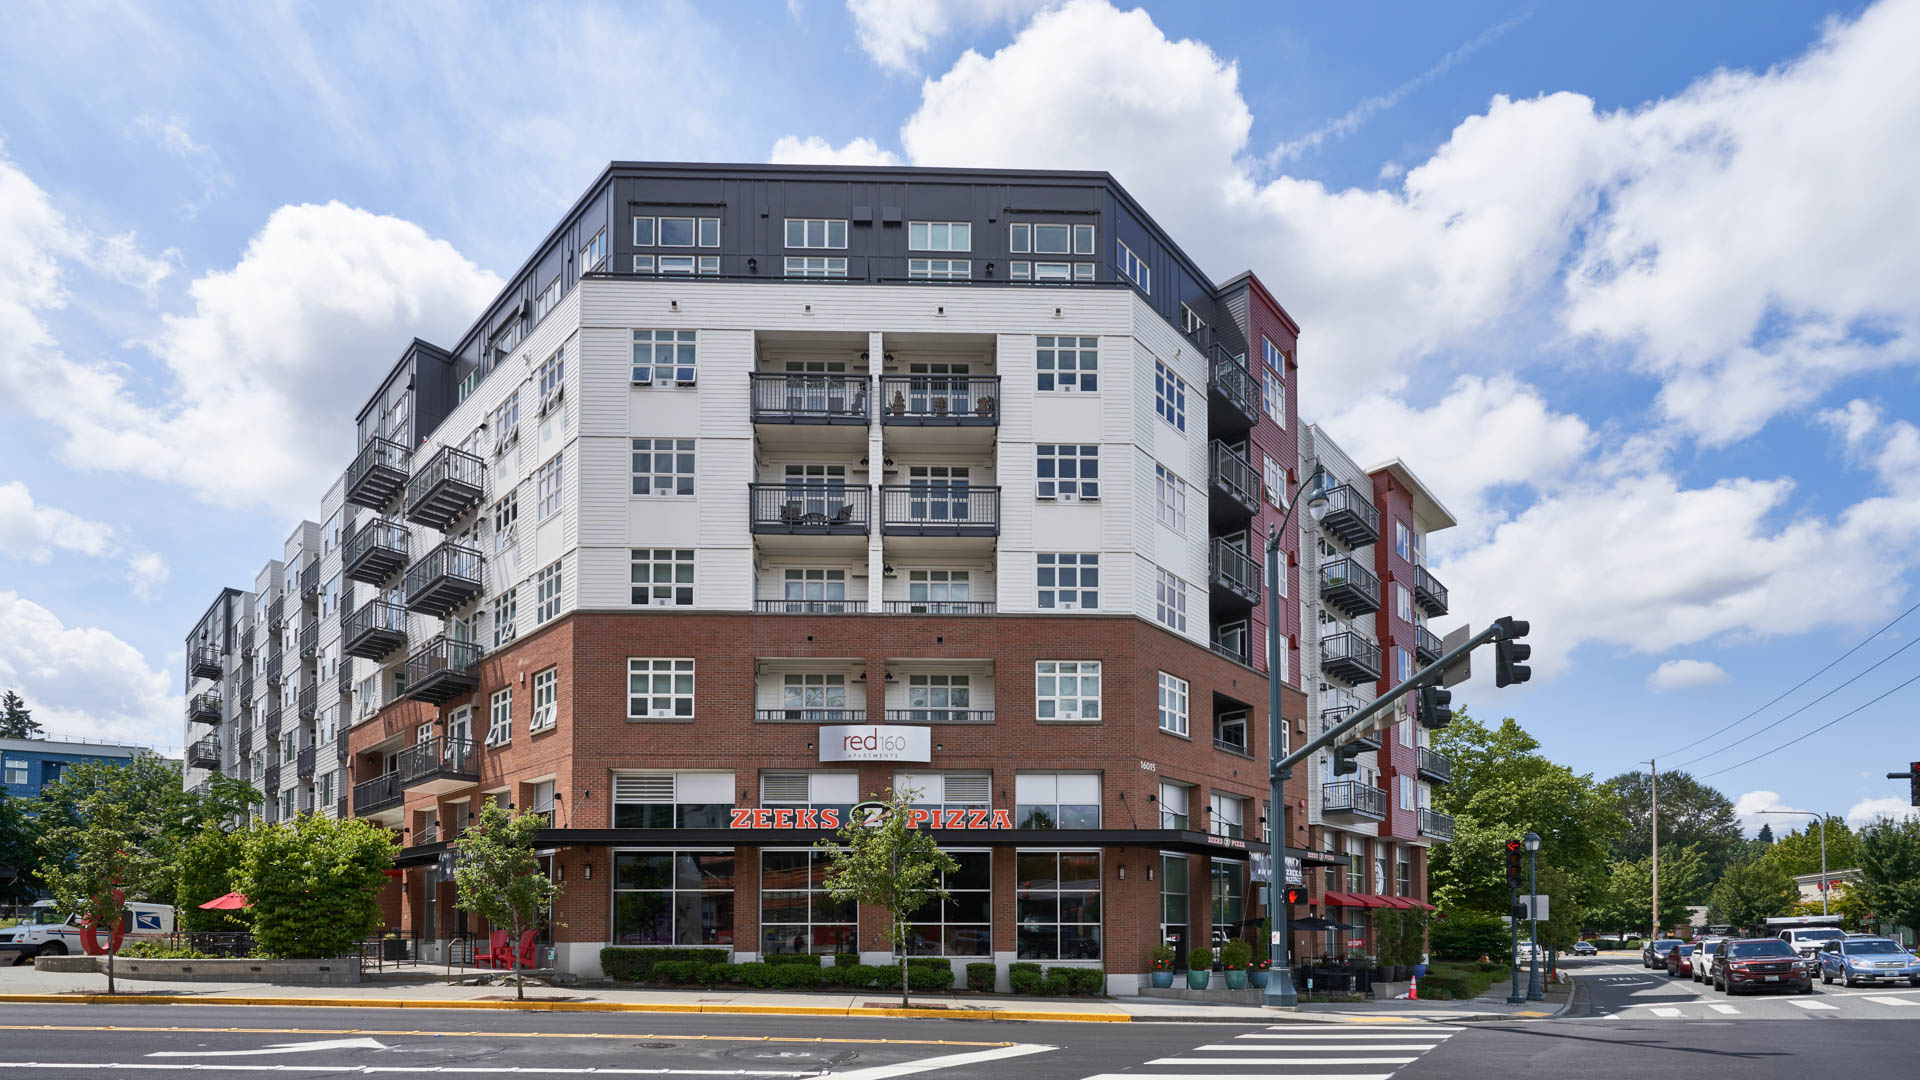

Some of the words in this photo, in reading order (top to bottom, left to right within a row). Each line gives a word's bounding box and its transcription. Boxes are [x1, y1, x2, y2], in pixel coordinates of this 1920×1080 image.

[1140, 760, 1156, 772] 16015
[731, 808, 839, 829] ZEEKS
[906, 809, 1013, 829] PIZZA
